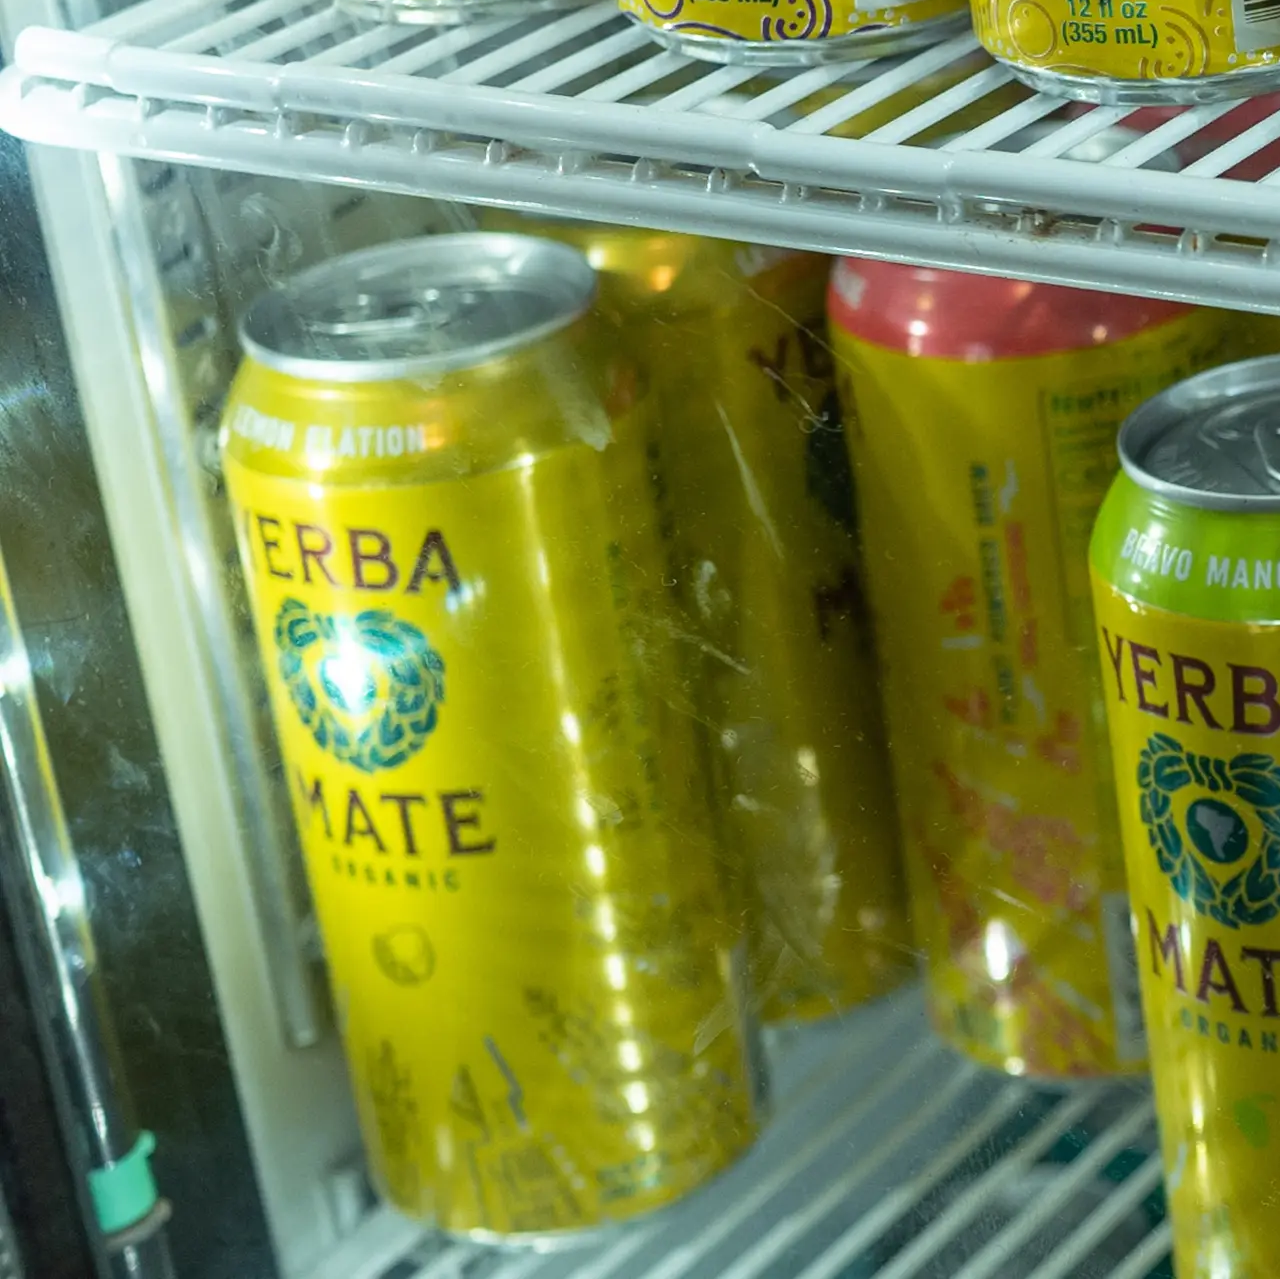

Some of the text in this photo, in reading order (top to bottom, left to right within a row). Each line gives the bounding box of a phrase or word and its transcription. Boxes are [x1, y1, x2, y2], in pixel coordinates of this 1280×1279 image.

[1121, 1, 1148, 19] oz
[1061, 23, 1158, 48] (355 mL)
[1121, 527, 1193, 582] BRAVO
